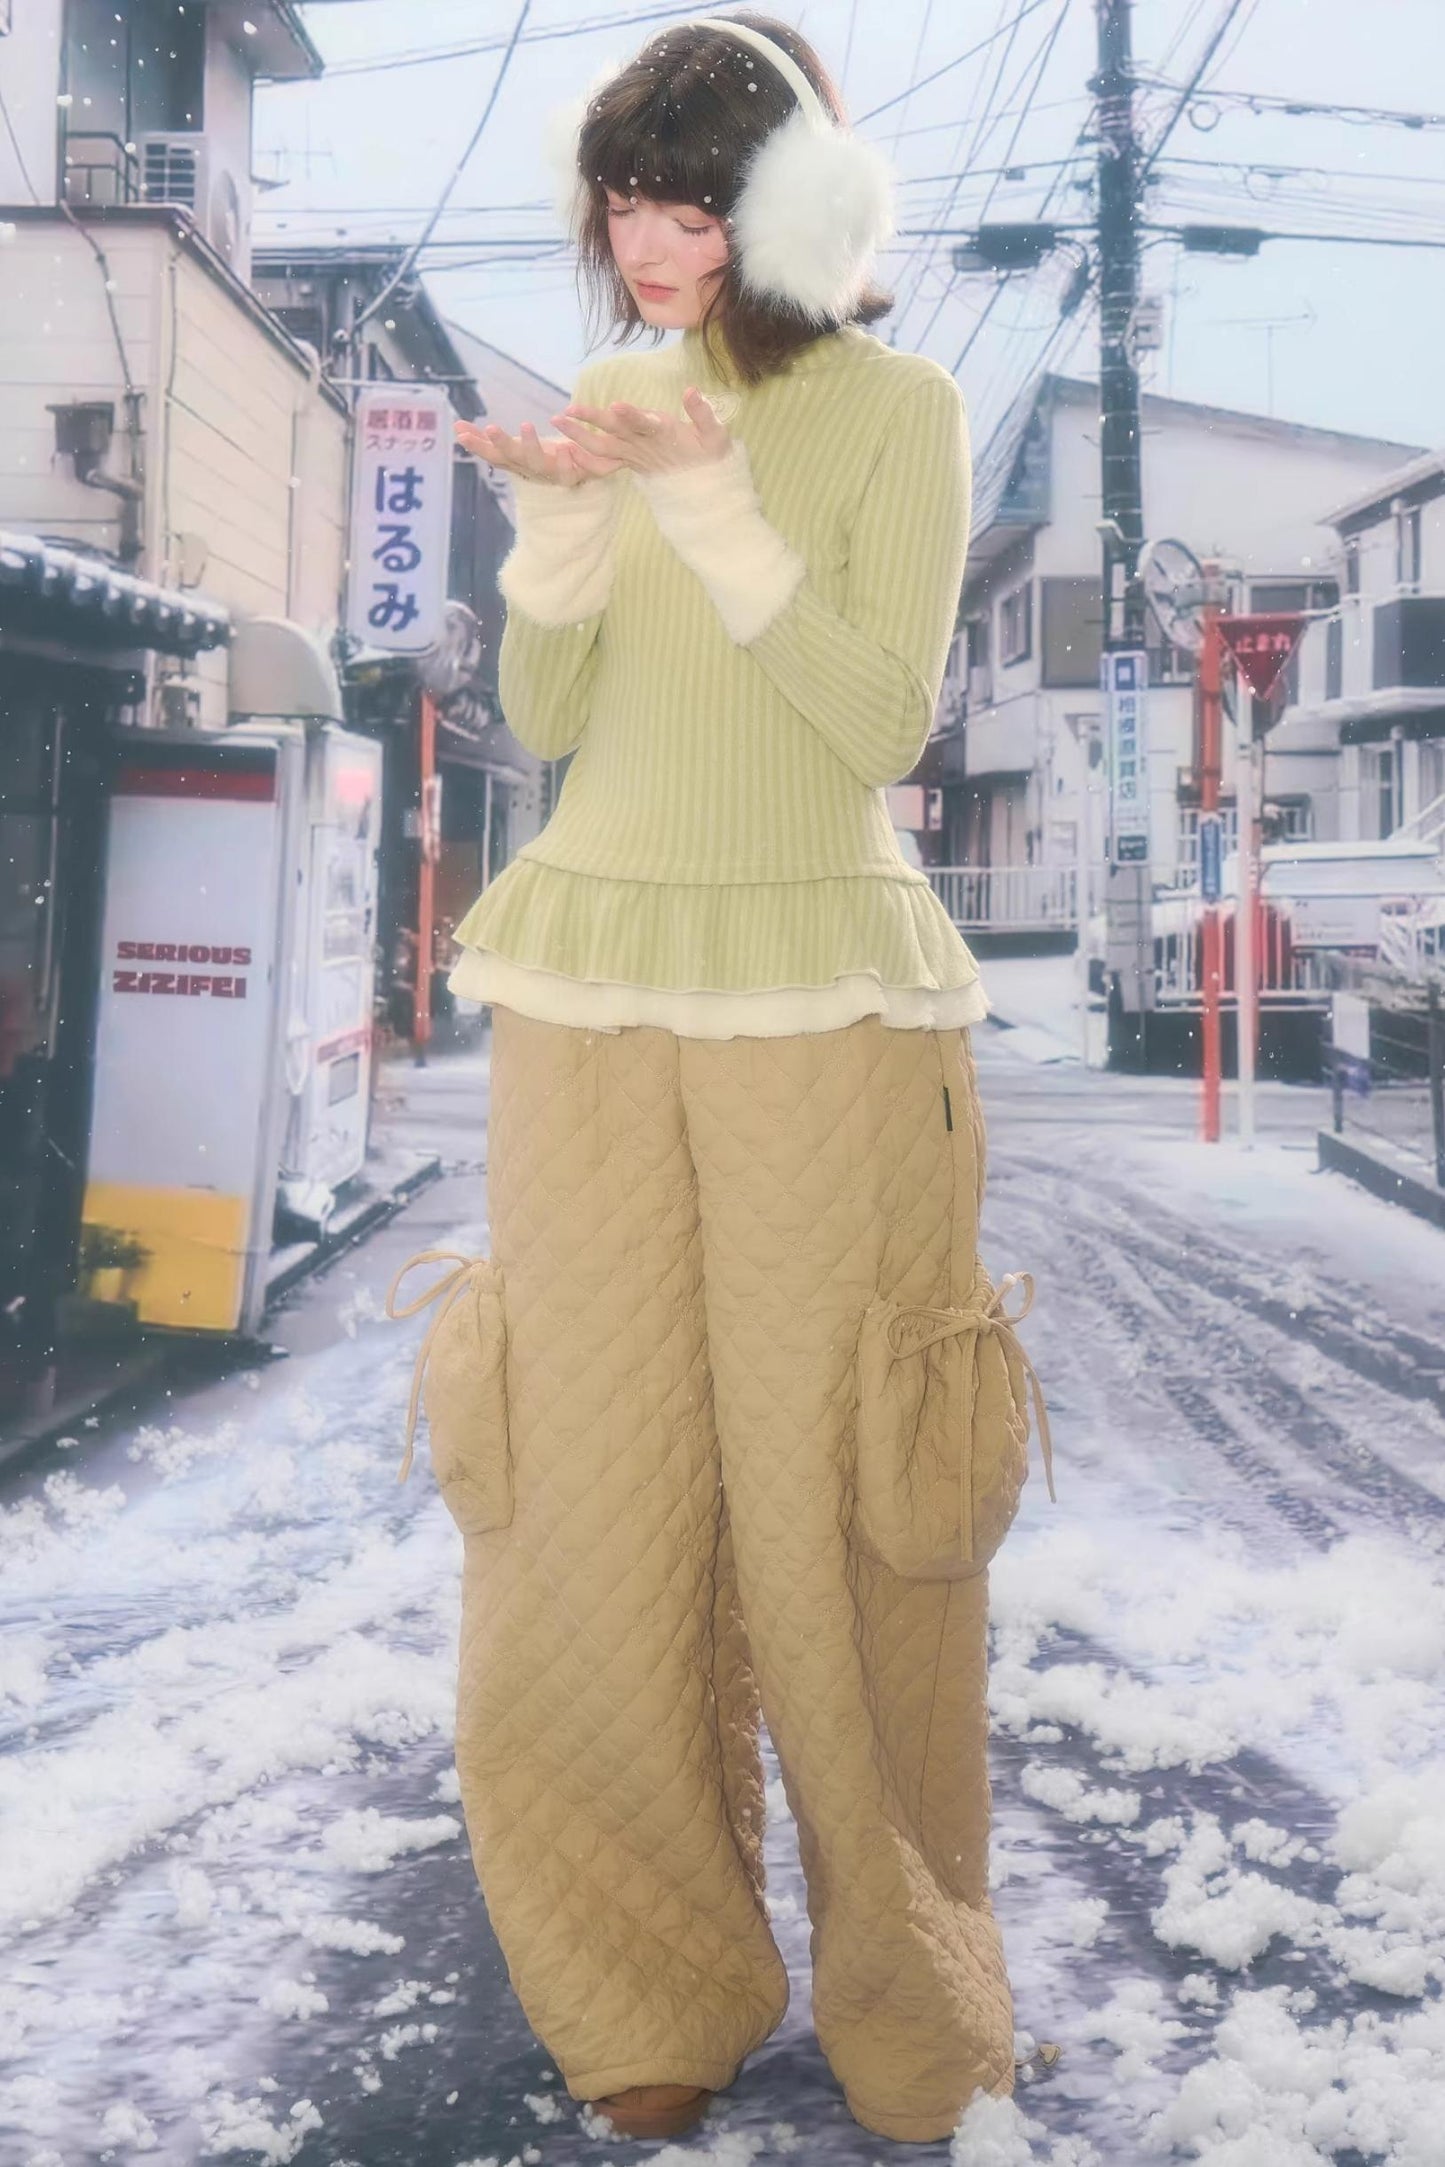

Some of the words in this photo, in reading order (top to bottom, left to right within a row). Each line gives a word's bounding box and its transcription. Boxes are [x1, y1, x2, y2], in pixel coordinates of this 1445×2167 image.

[366, 434, 437, 452] スナック
[368, 466, 424, 632] はるみ
[117, 941, 252, 965] SERIOUS
[113, 970, 247, 998] ZIZIFEI
